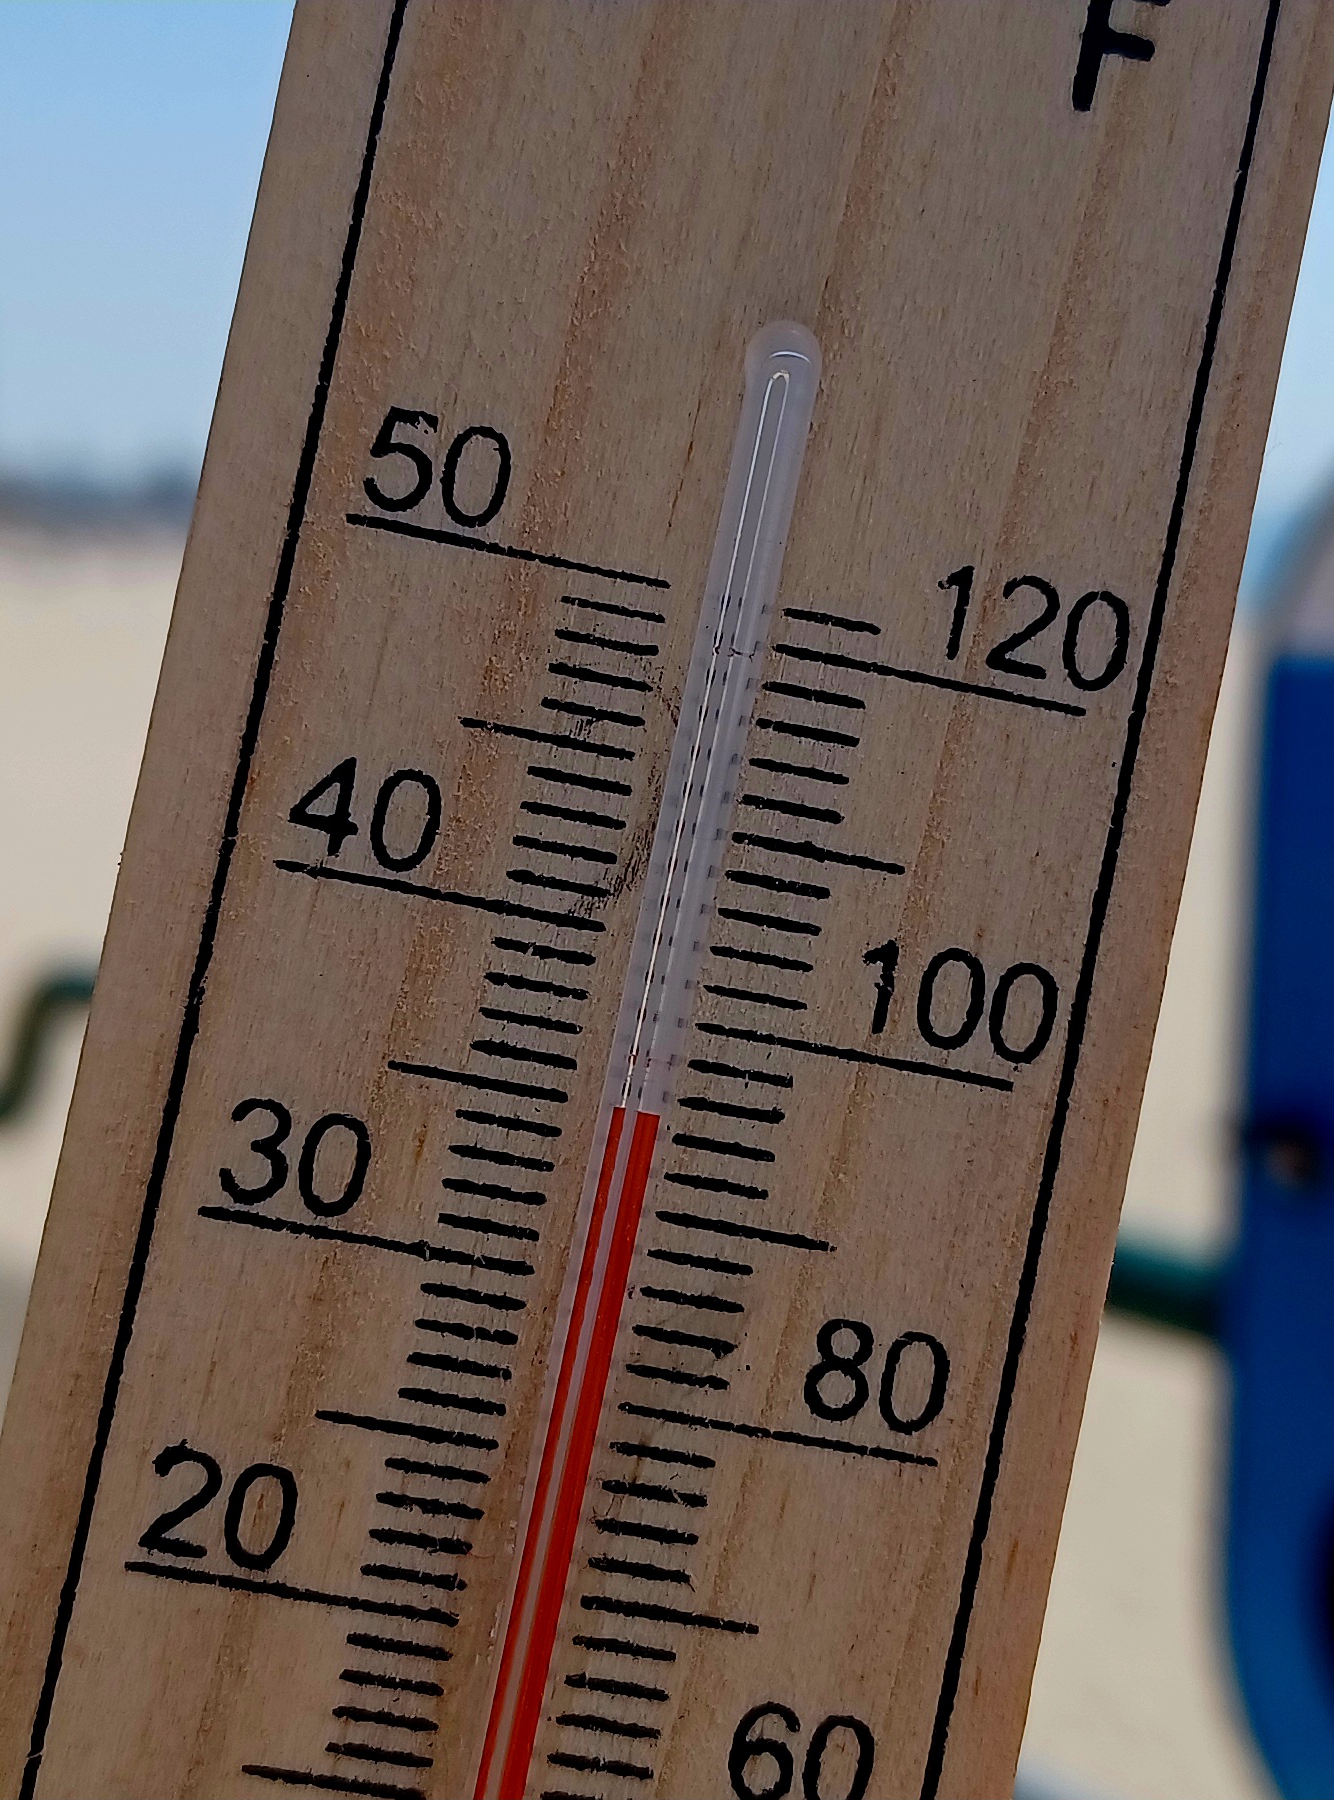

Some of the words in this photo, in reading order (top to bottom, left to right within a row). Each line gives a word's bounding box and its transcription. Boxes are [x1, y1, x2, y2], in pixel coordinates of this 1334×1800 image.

[360, 406, 512, 528] 50
[936, 563, 1131, 692] 120
[286, 757, 443, 874] 40
[859, 938, 1059, 1065] 100
[217, 1097, 372, 1218] 30
[801, 1316, 951, 1437] 80
[137, 1439, 300, 1570] 20
[725, 1700, 879, 1800] 60
